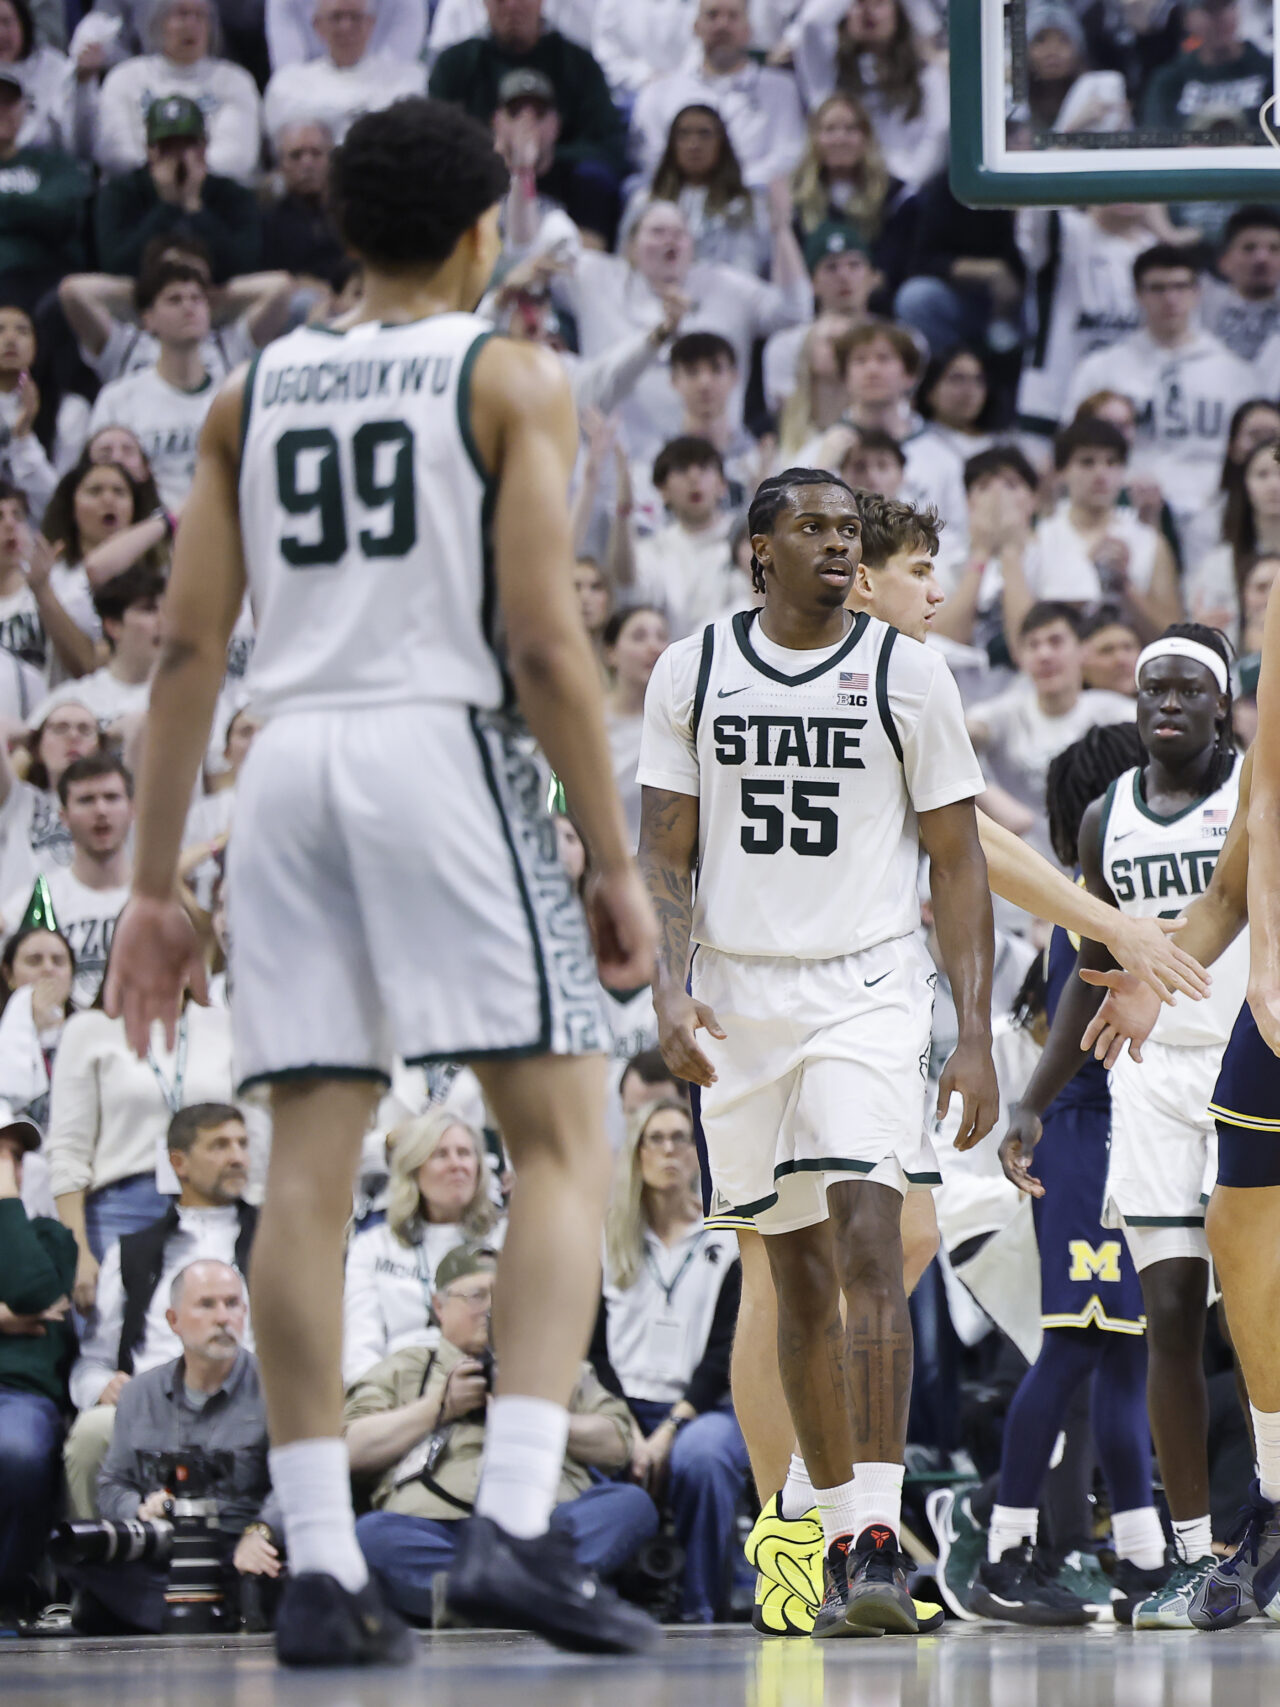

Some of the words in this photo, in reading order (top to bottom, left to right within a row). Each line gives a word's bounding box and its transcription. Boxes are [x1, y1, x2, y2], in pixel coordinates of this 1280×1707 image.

[262, 356, 453, 409] UGOCHUKWU
[276, 420, 416, 567] 99
[713, 715, 868, 769] STATE
[740, 778, 840, 857] 55
[1068, 1239, 1121, 1282] M
